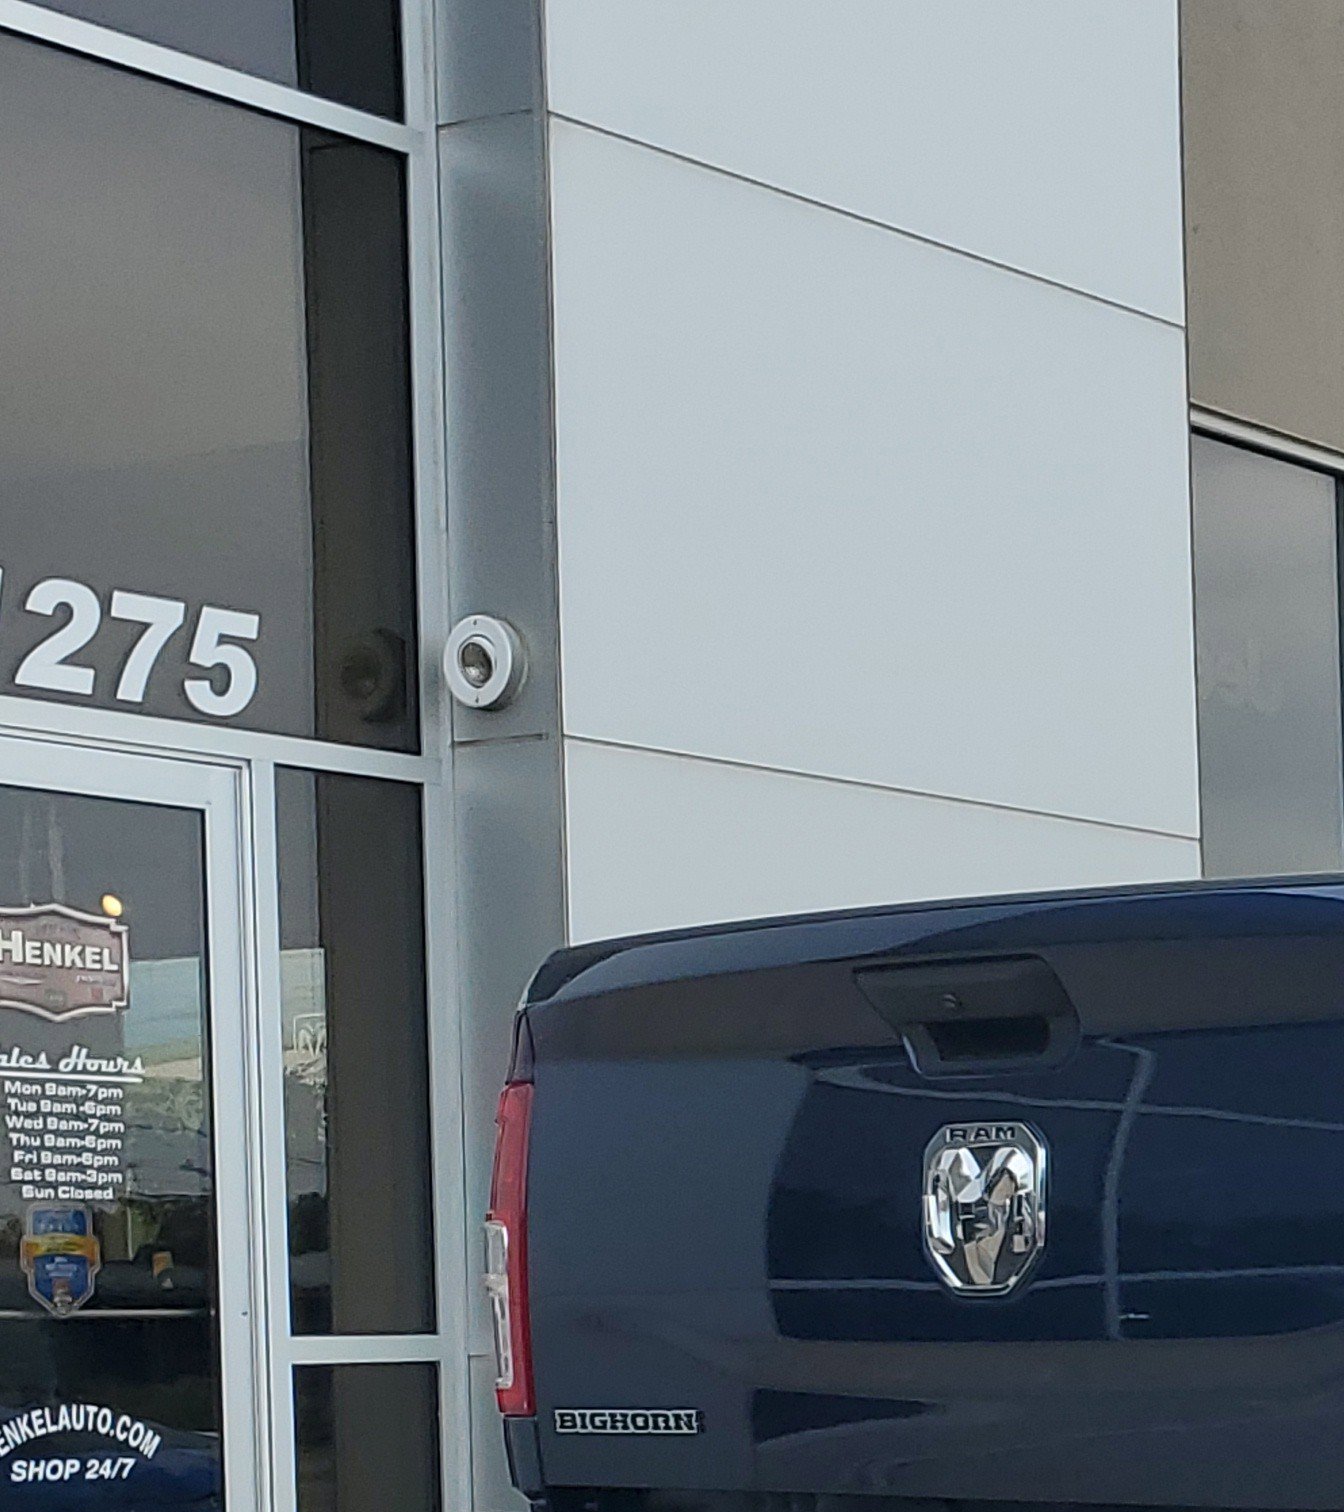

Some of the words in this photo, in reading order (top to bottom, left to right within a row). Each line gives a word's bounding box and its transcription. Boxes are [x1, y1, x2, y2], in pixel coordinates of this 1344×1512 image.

[0, 566, 260, 716] 275
[0, 929, 119, 971] HENKEL
[59, 1045, 146, 1073] Hours
[4, 1080, 42, 1095] Mon
[7, 1097, 37, 1112] Tue
[5, 1115, 43, 1130] Wed
[9, 1133, 41, 1147] Thu
[945, 1126, 1016, 1142] RAM
[13, 1150, 37, 1164] Fri
[11, 1167, 42, 1182] Sat
[22, 1185, 54, 1199] Sun
[58, 1186, 113, 1200] Closed
[555, 1410, 698, 1434] BIGHORN
[11, 1459, 80, 1482] SHOP
[85, 1457, 136, 1480] 24/7
